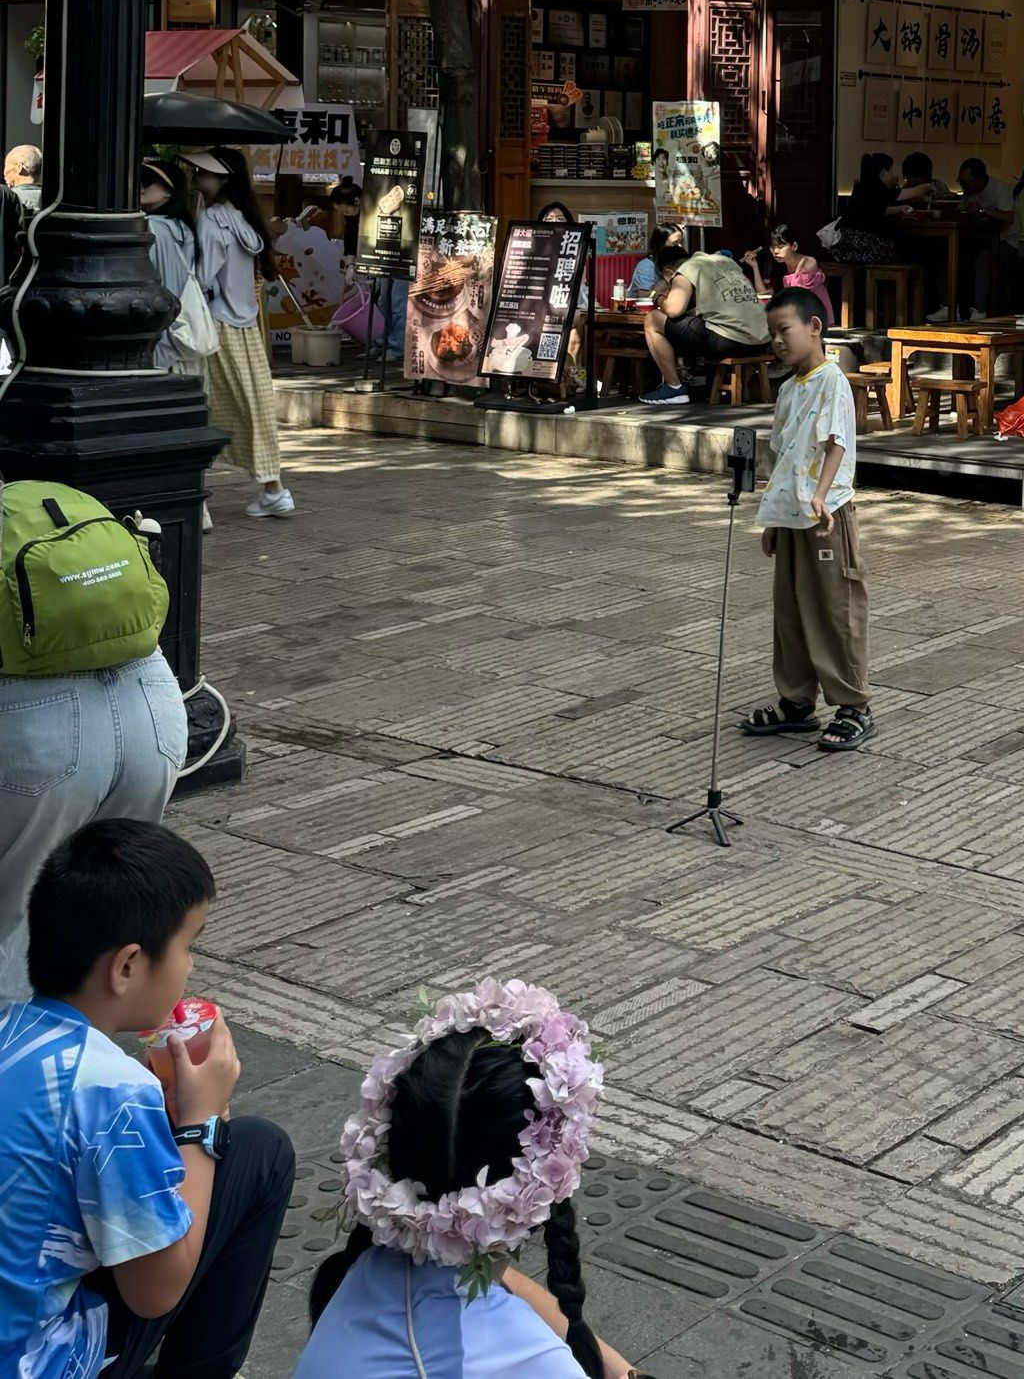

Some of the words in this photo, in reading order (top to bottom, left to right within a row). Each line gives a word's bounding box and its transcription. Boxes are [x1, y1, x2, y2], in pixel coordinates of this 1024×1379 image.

[872, 15, 981, 60] 大锅骨汤
[549, 230, 582, 310] 招聘啦
